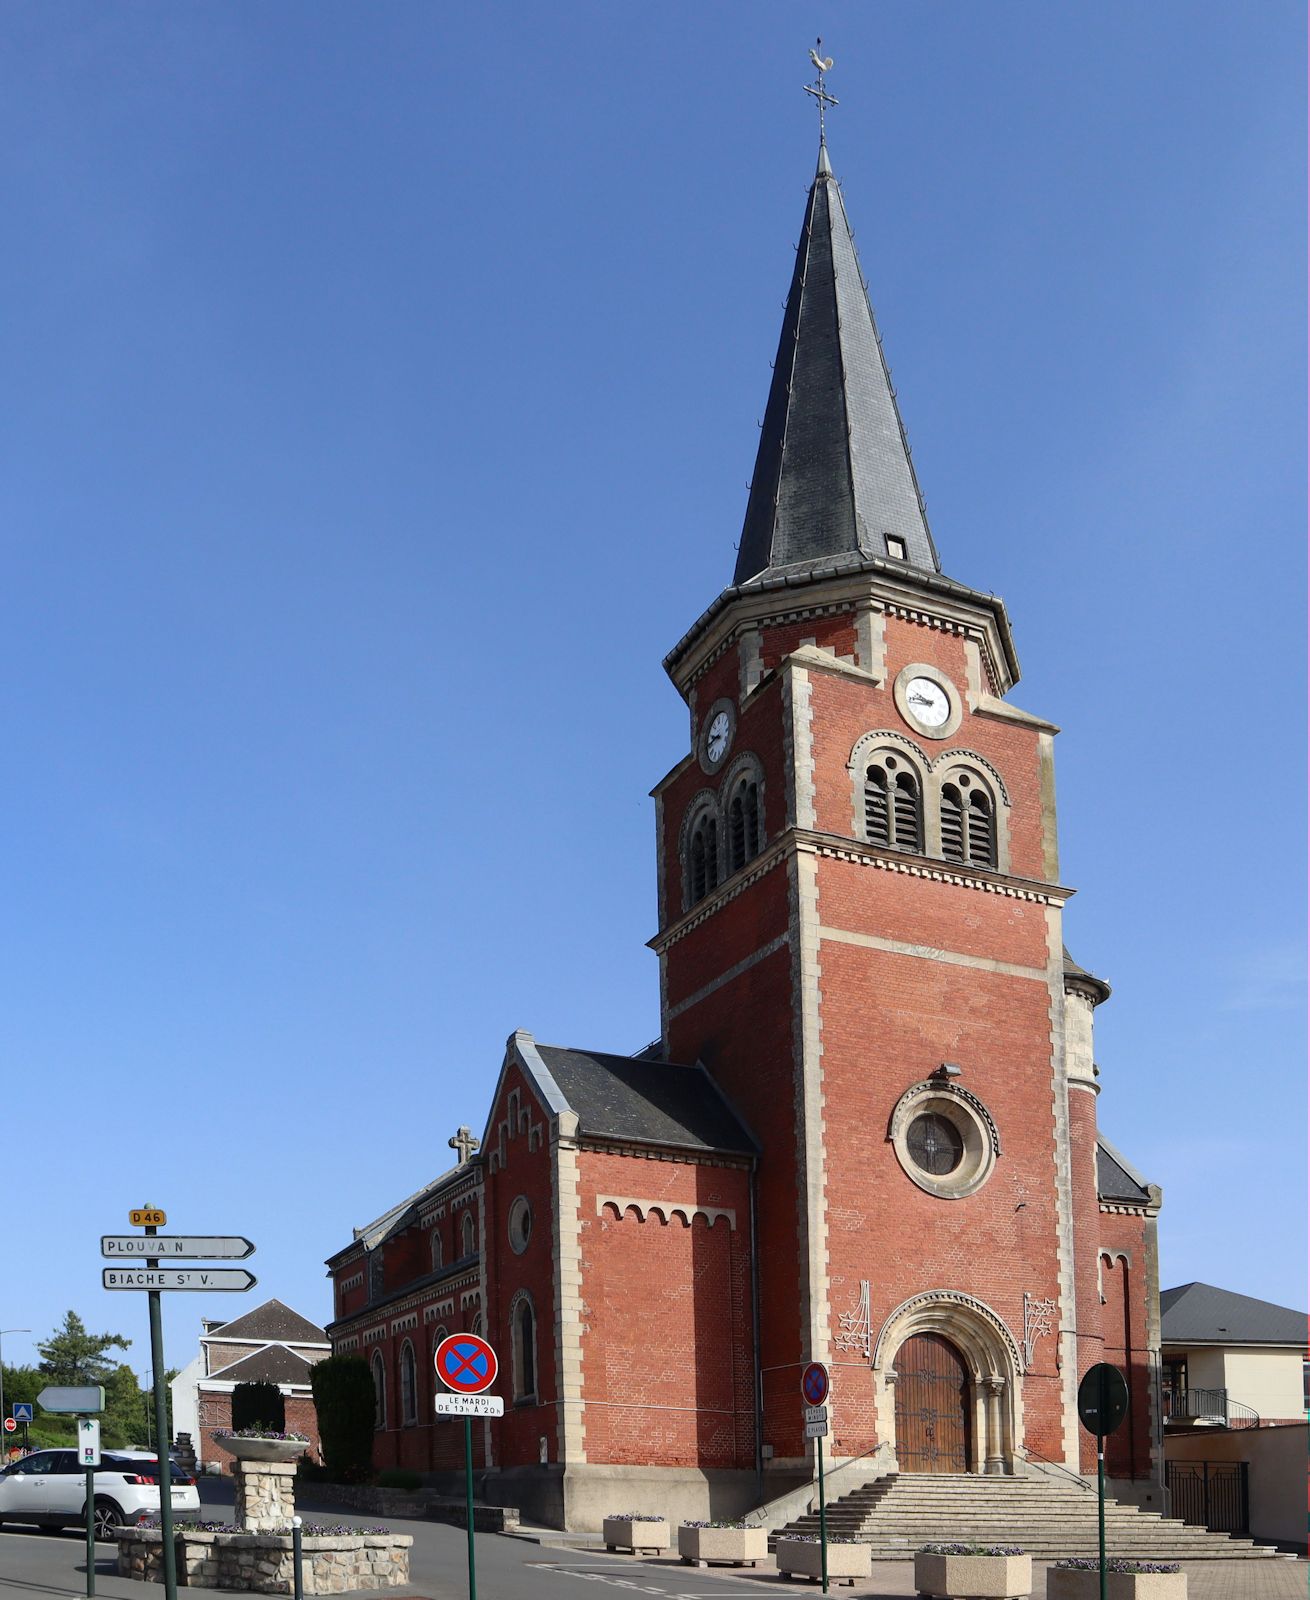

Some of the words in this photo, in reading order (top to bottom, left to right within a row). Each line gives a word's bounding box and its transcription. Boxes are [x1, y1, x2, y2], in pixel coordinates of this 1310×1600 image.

[133, 1213, 141, 1222] D
[144, 1213, 161, 1222] 46
[108, 1241, 183, 1252] PLOUVAN
[109, 1275, 165, 1284] BIACHE
[462, 1397, 490, 1405] MARDI
